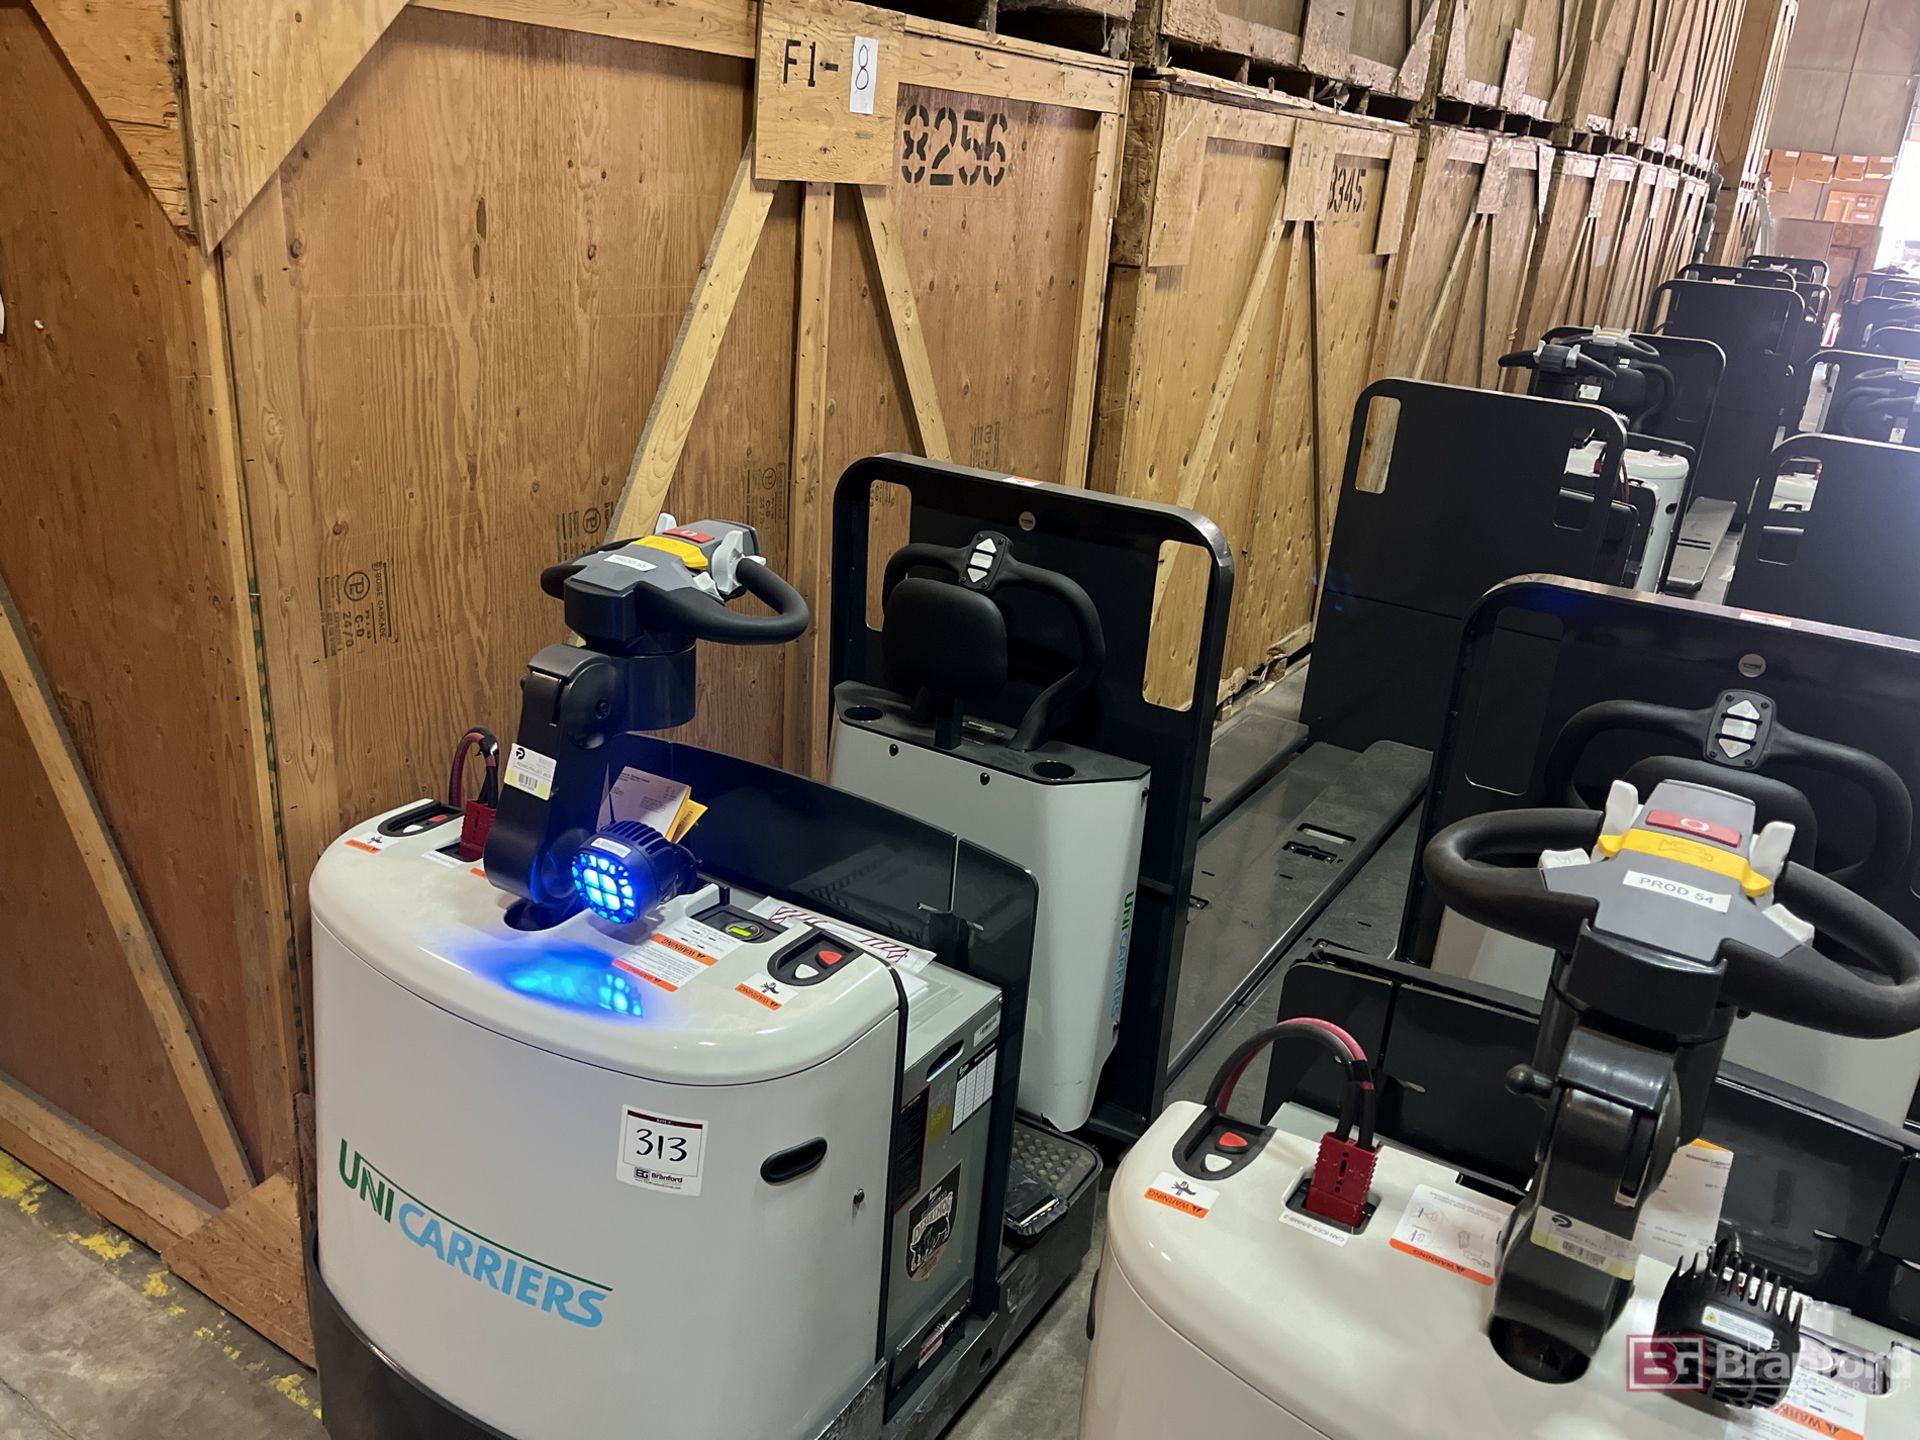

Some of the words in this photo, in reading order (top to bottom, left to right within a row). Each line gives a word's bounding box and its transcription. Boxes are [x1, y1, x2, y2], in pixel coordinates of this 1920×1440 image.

[855, 44, 870, 91] 8
[901, 104, 1008, 187] 8256
[1640, 877, 1690, 897] PROD
[1694, 892, 1714, 905] 54
[635, 1127, 688, 1162] 313
[651, 1172, 683, 1183] Branford
[1412, 1249, 1456, 1269] WARNING
